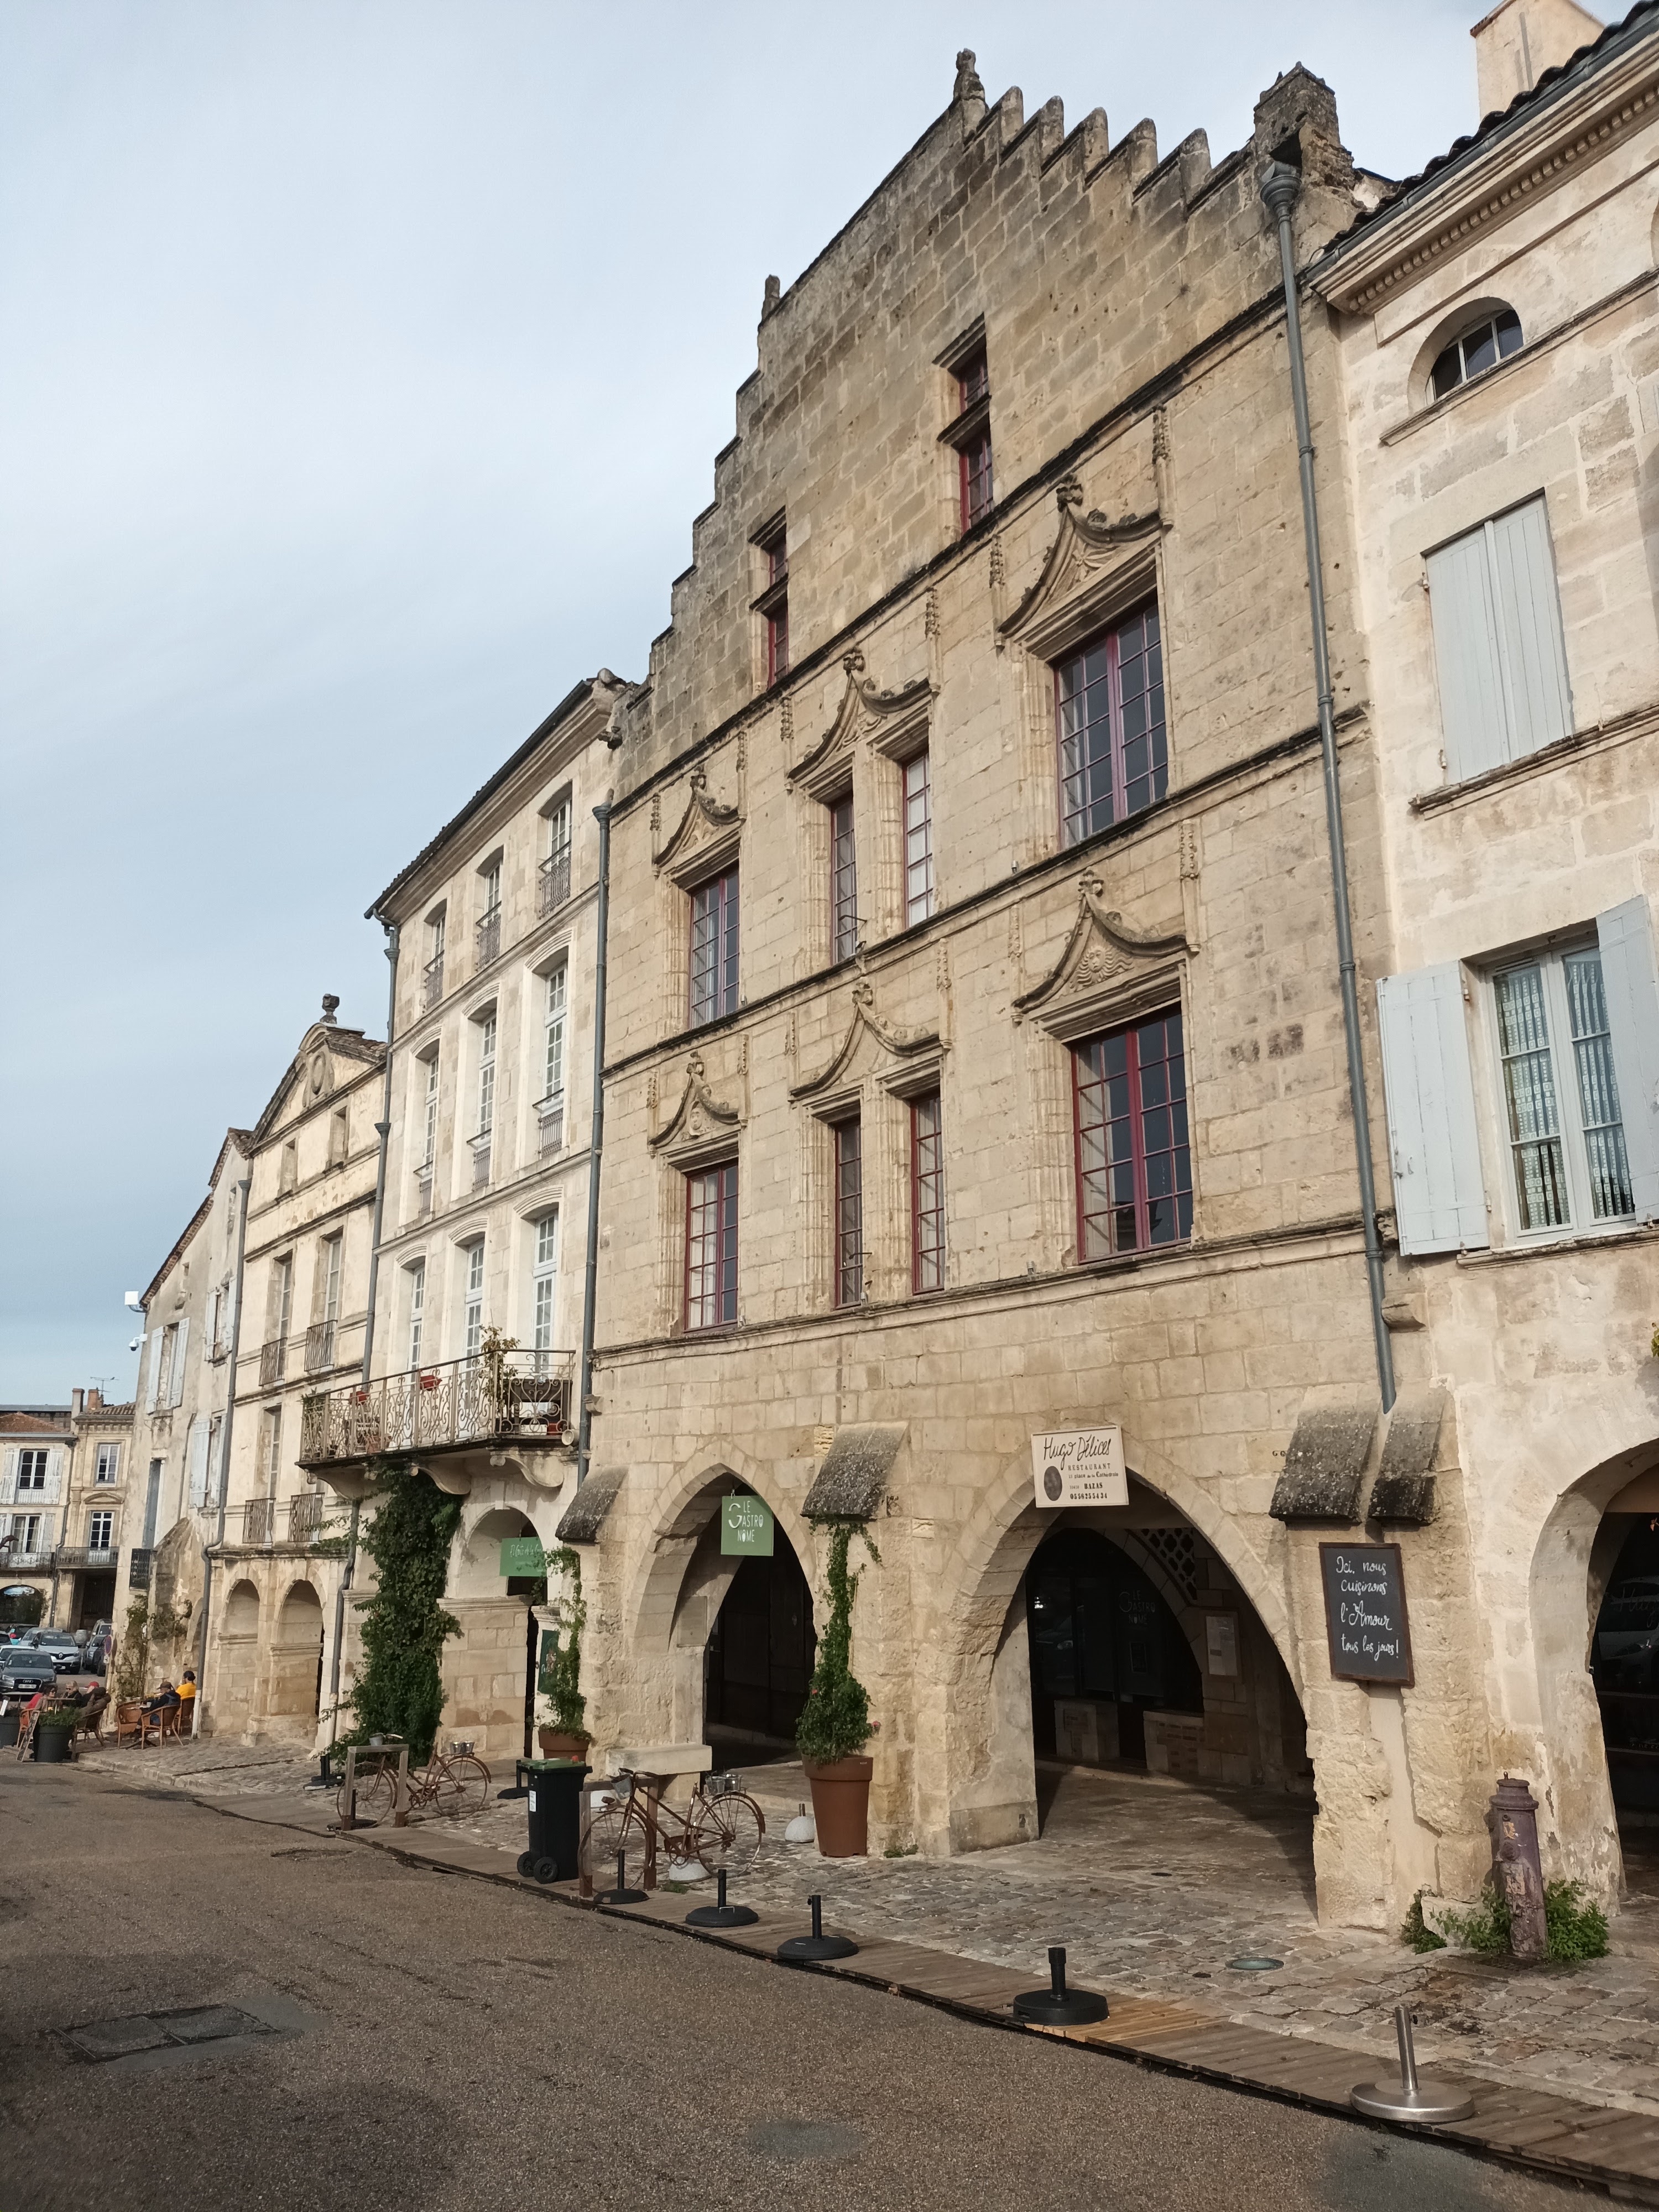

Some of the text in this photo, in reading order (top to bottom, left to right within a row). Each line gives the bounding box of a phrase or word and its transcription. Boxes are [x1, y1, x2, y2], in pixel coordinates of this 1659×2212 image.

[1044, 1434, 1111, 1470] Hugo Délices
[743, 1501, 750, 1512] LE
[728, 1503, 764, 1528] GASTRO
[737, 1530, 755, 1542] NOME
[1363, 1562, 1386, 1575] nous
[1133, 1590, 1141, 1600] LE
[1340, 1600, 1392, 1630] l'Amour
[1341, 1634, 1358, 1653] tous
[1363, 1635, 1374, 1652] les
